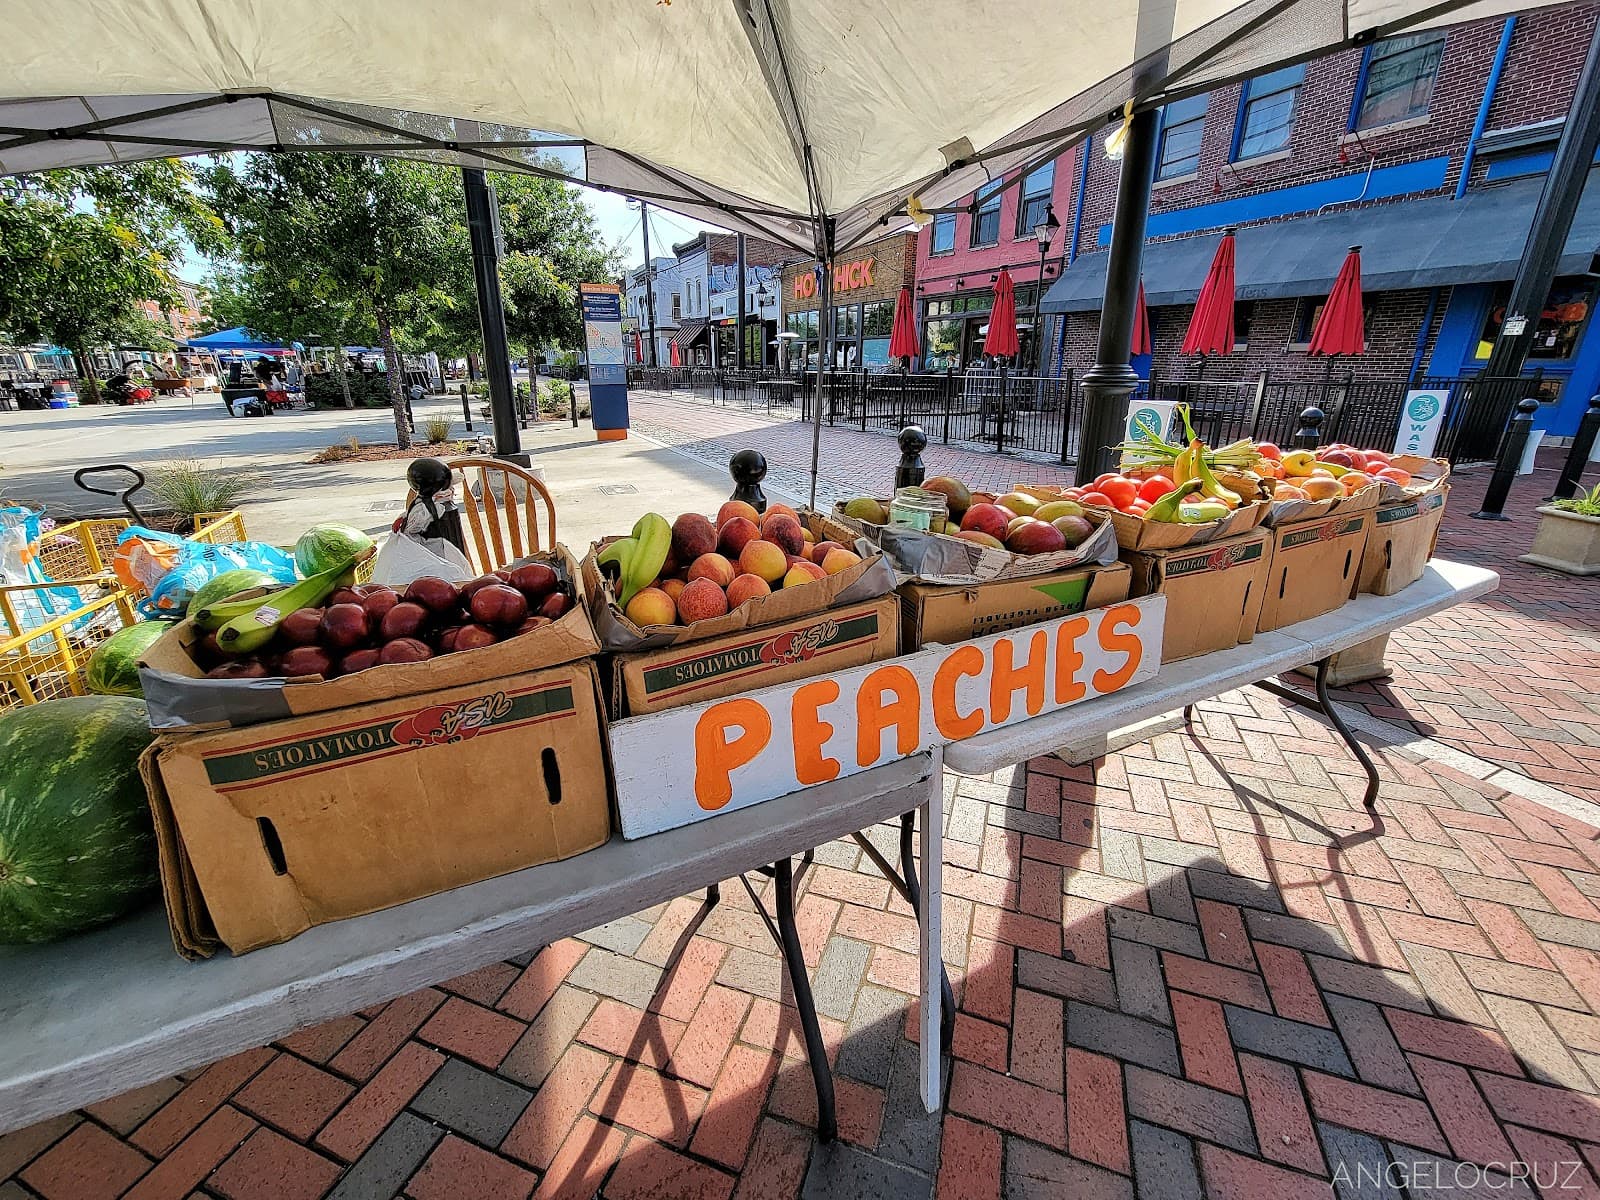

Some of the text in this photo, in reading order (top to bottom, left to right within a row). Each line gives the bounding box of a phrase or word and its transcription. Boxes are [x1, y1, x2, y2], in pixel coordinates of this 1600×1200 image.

[826, 257, 874, 293] HICK
[1406, 424, 1427, 455] WAS
[676, 619, 840, 682] USA TOMATOES
[254, 691, 512, 773] USA TOMATOES
[694, 604, 1142, 811] PEACHES
